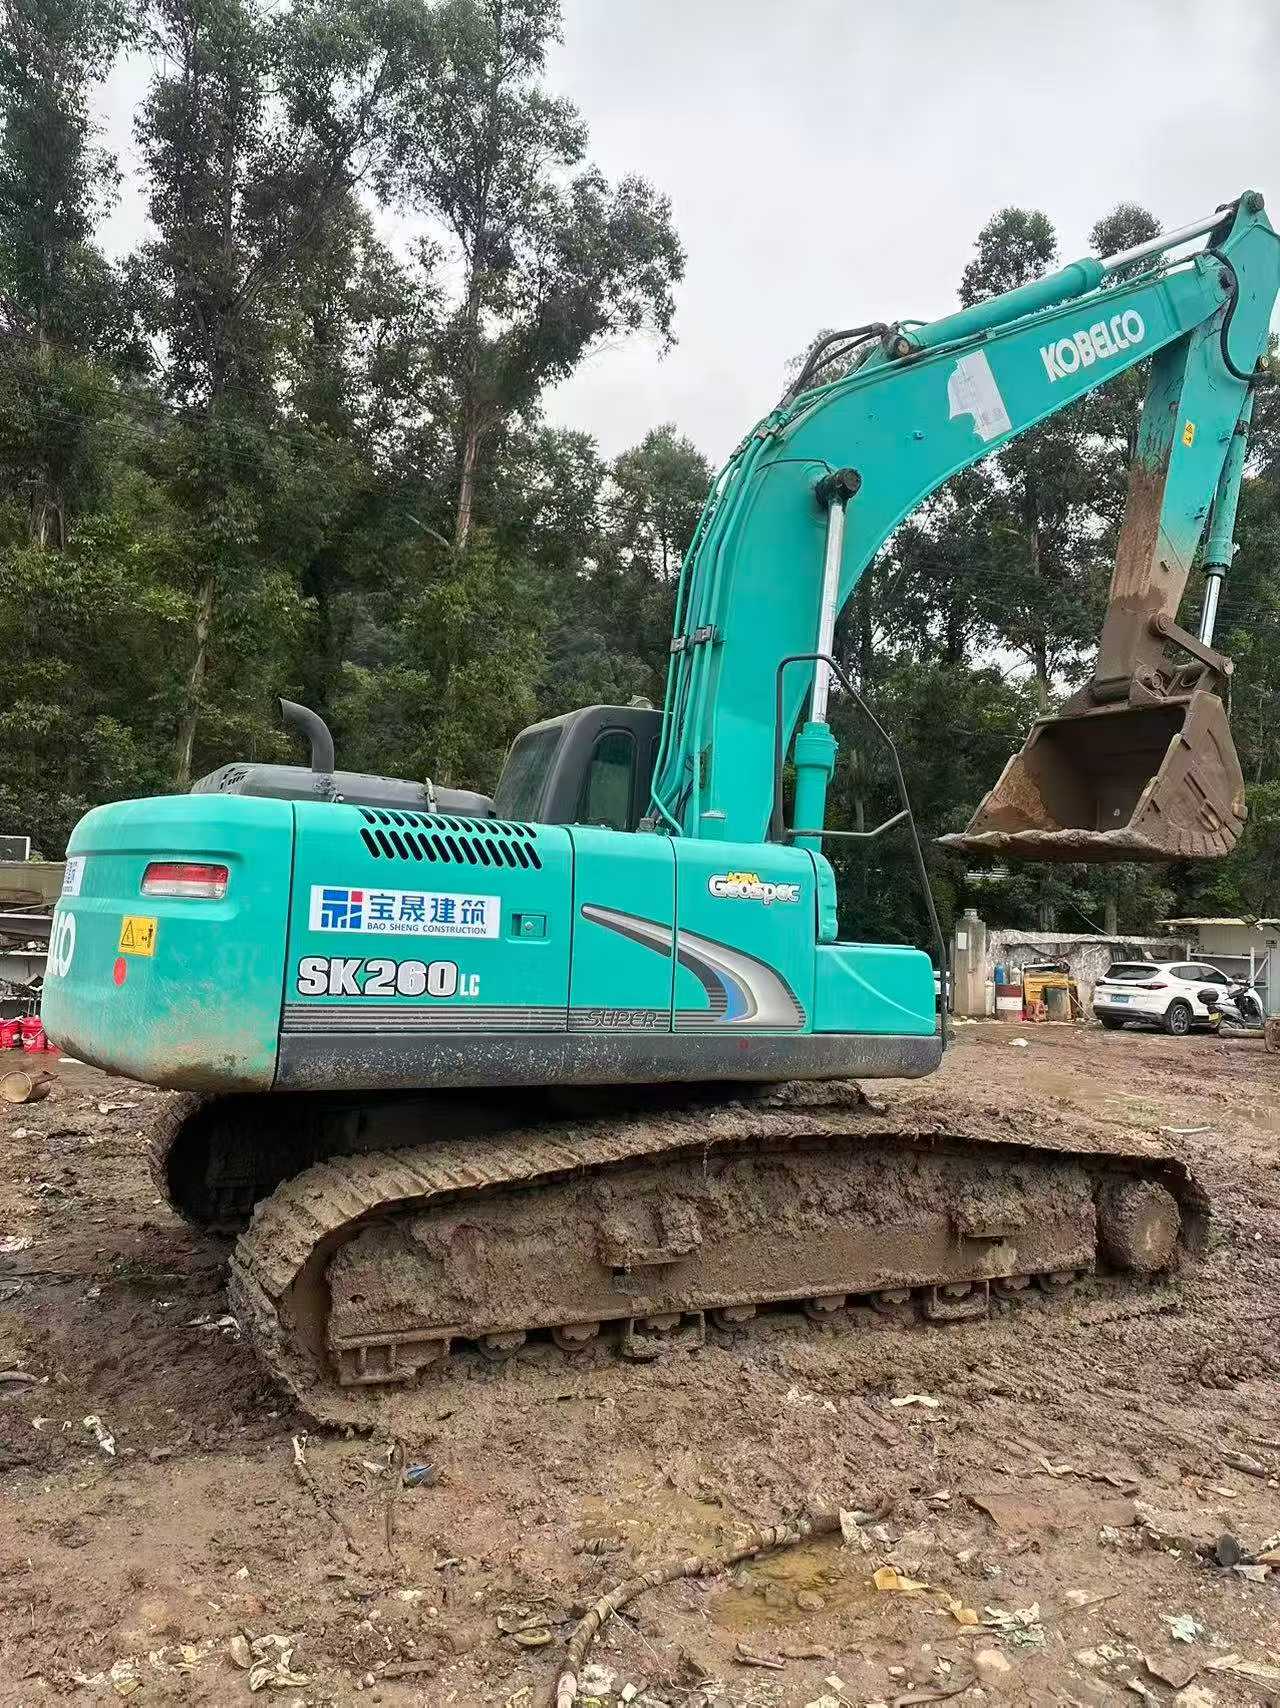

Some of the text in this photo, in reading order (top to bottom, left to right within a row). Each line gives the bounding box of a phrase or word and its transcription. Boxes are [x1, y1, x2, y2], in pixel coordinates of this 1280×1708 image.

[1039, 309, 1145, 383] KOBELCO
[368, 893, 487, 925] 宝晟建筑
[367, 922, 487, 935] BAO SHENG CONSTRUCTION
[297, 955, 459, 998] SK260
[584, 1010, 657, 1029] SUPER
